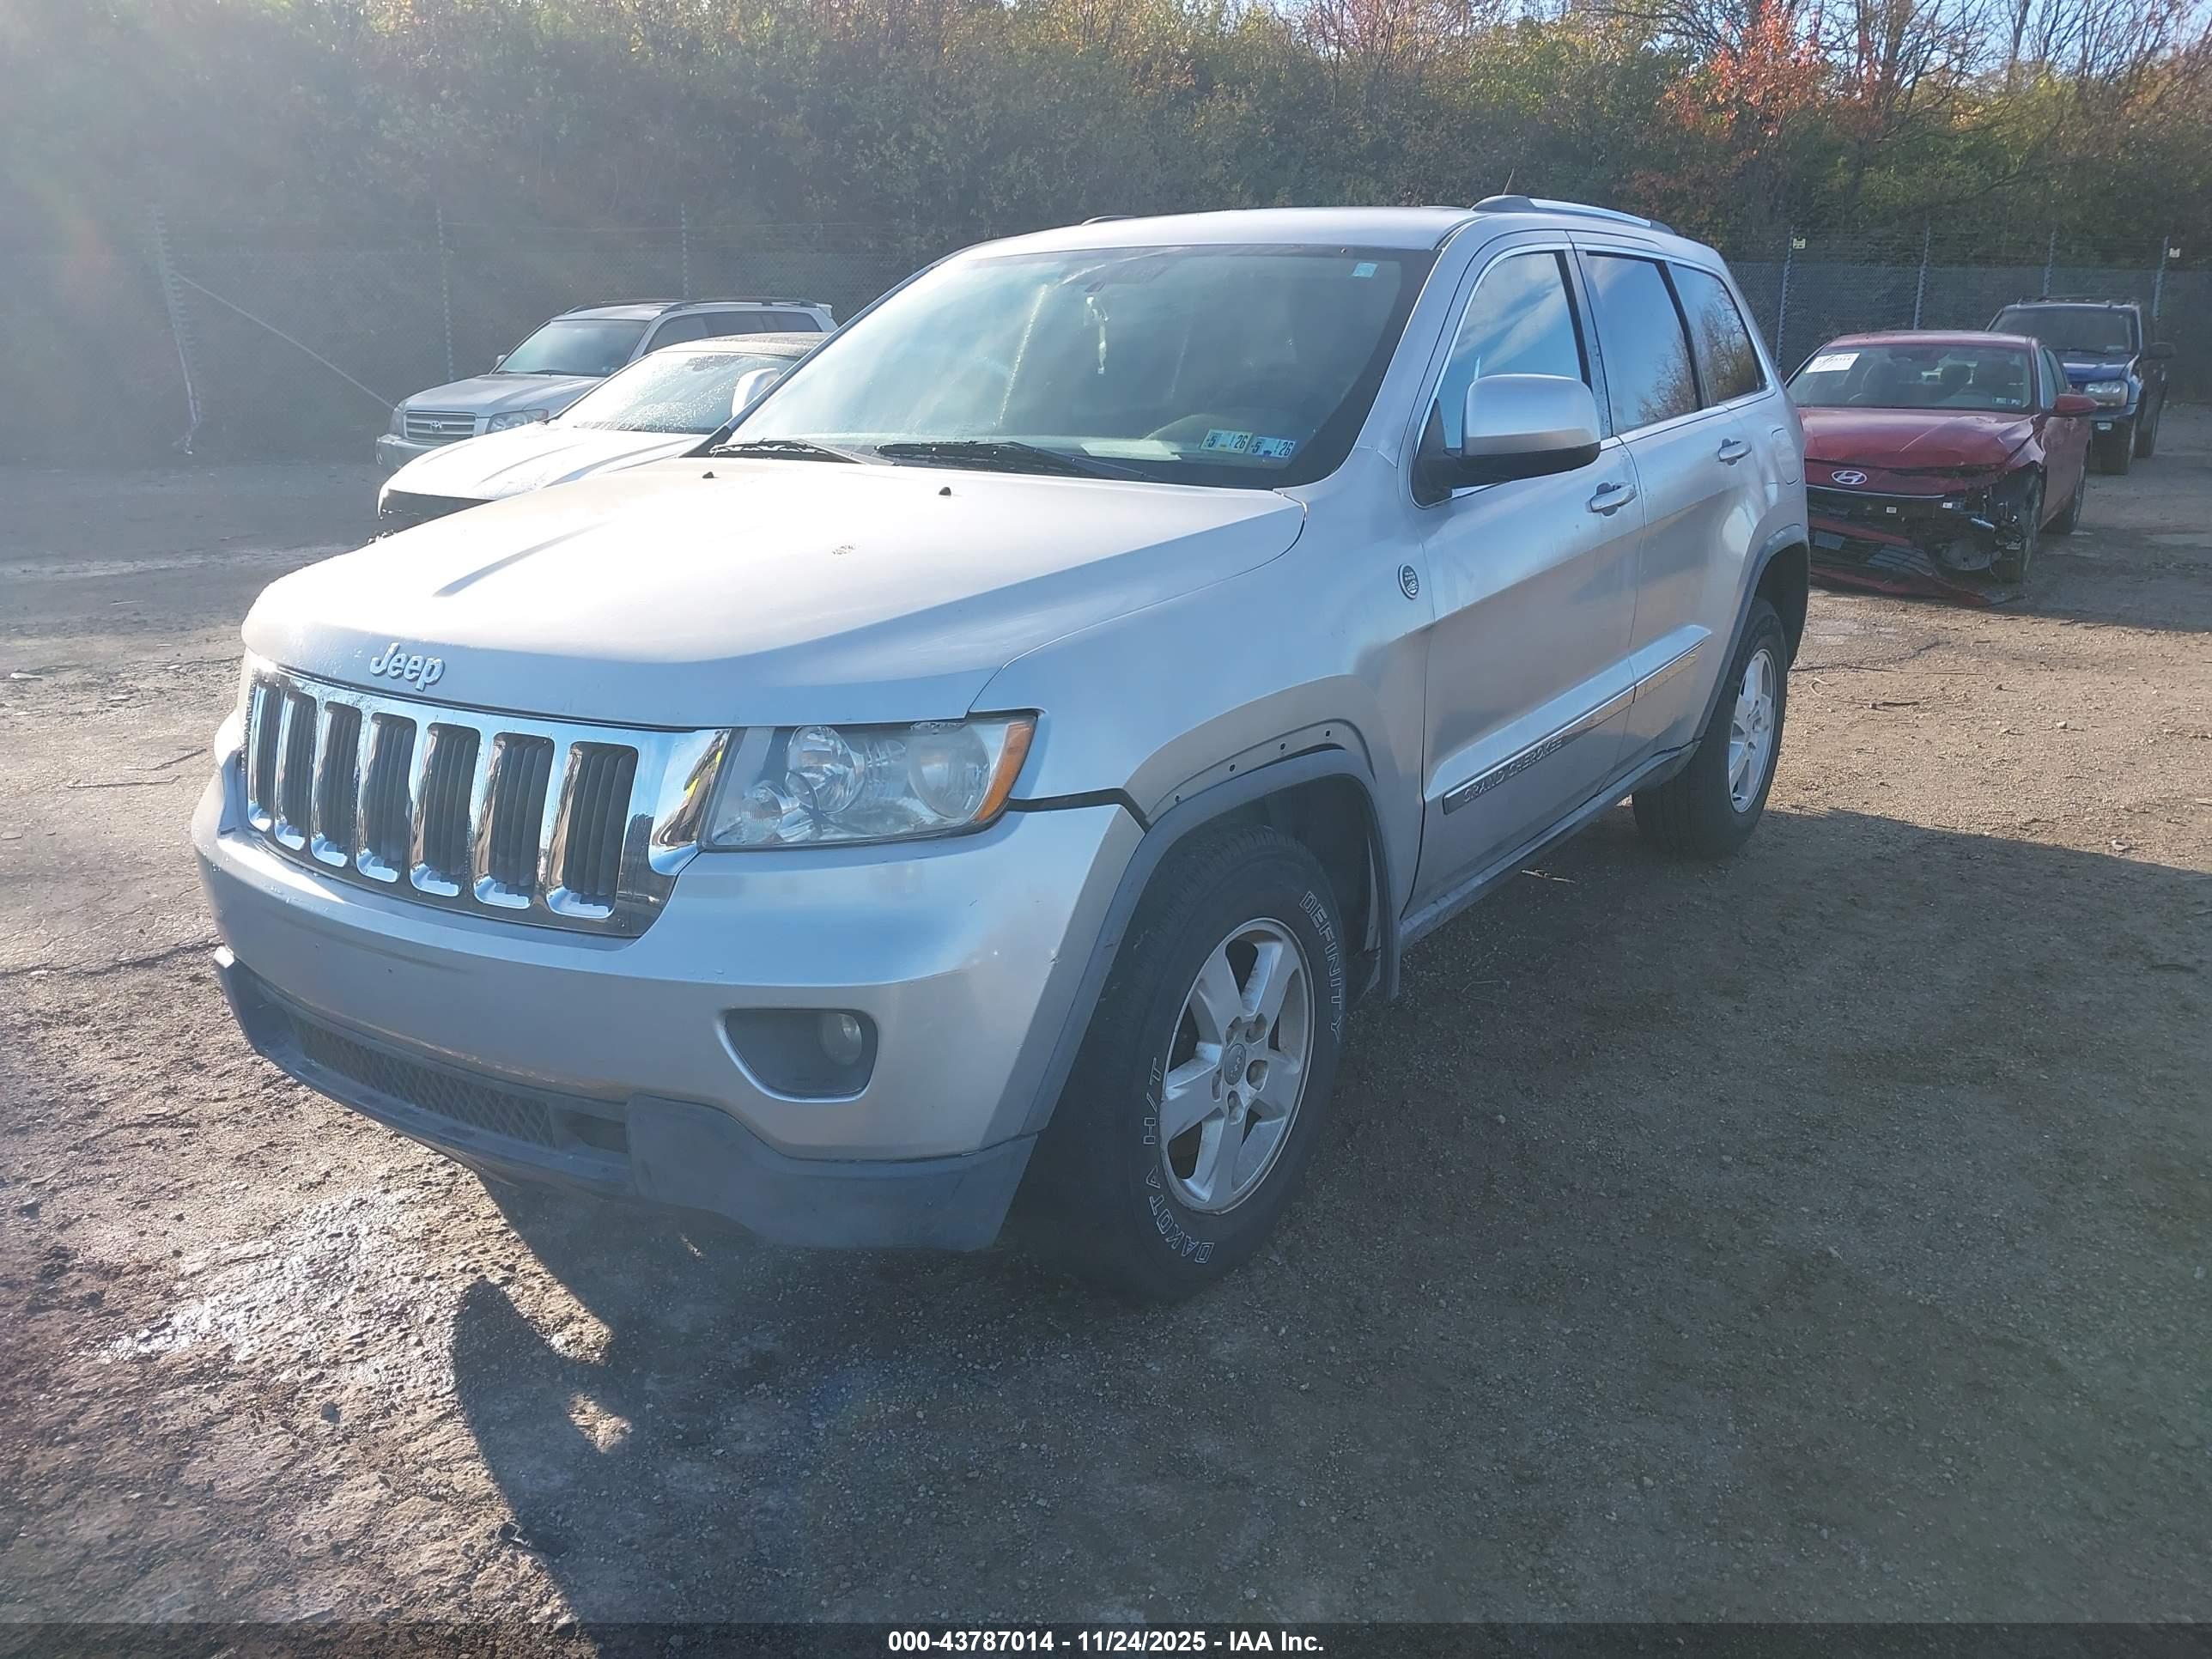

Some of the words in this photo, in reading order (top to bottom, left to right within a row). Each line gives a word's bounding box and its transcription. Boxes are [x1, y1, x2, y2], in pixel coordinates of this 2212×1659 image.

[1235, 434, 1249, 449] 26
[1279, 441, 1293, 456] 26
[369, 641, 445, 692] Jeep
[1463, 770, 1504, 802] GRAND
[1509, 735, 1563, 777] CHEROKEE
[1298, 890, 1341, 1044] DEFINITY
[1143, 1056, 1162, 1146] H/T
[1146, 1164, 1215, 1264] DAKOTA
